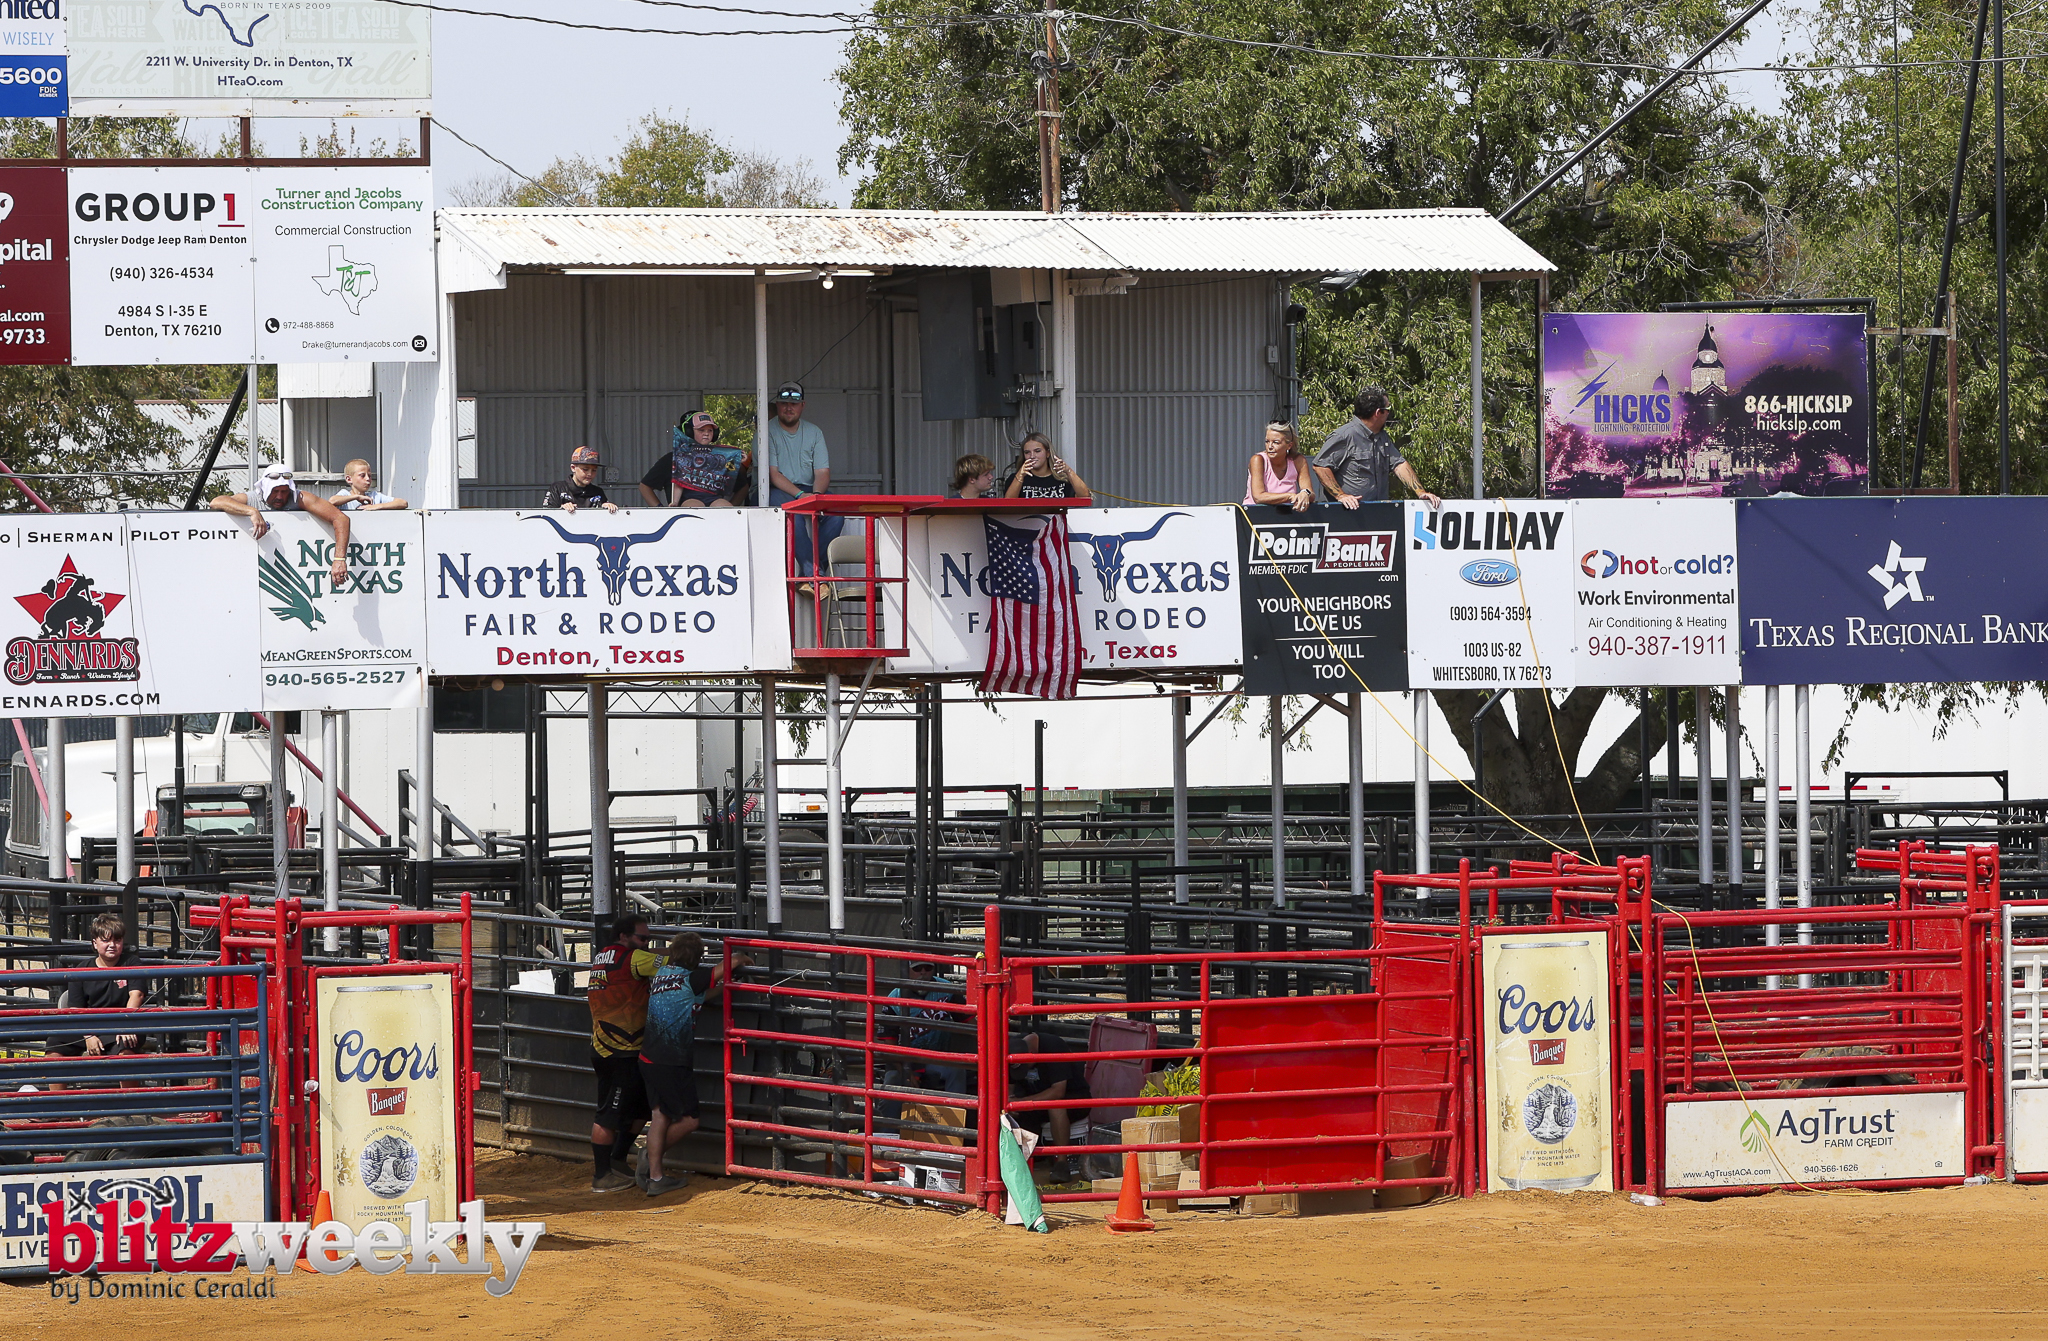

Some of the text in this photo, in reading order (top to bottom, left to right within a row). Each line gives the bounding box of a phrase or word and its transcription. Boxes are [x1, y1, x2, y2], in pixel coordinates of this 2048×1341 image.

[269, 2, 301, 10] TEXAS
[305, 2, 332, 10] 2009
[3, 31, 55, 46] WISELY
[146, 57, 171, 67] 2211
[174, 57, 189, 67] W.
[193, 56, 250, 70] University
[254, 57, 271, 67] Dr.
[274, 57, 285, 67] in
[289, 57, 334, 69] Denton,
[337, 57, 353, 67] TX
[0, 67, 62, 85] 5600
[217, 75, 284, 86] HTeaO.com
[39, 86, 58, 94] FDIC
[276, 187, 402, 199] Turner and Jacobs
[75, 193, 216, 222] GROUP
[261, 198, 423, 211] Construction Company
[275, 224, 412, 236] Commercial Construction
[73, 235, 247, 247] Chrysler Dodge Jeep Ram Denton
[110, 266, 214, 282] (940) 326-4534
[118, 304, 208, 317] 4984 S I-35 E
[104, 324, 222, 338] Denton, TX 76210
[283, 321, 335, 329] 972-488-8868
[302, 340, 409, 350] Drake@turnerandjacobs.com
[1594, 394, 1671, 424] HICKS
[1744, 395, 1853, 414] 866-HICKSLP
[1594, 423, 1670, 433] LIGHTNING PROTECTION
[1756, 414, 1842, 432] hickslp.com
[27, 531, 113, 544] SHERMAN
[131, 529, 239, 542] PILOT POINT
[1413, 511, 1565, 551] HOLIDAY
[1257, 529, 1321, 557] Point
[1325, 536, 1386, 562] Bank
[437, 552, 588, 599] North
[1249, 564, 1308, 575] MEMBER FDIC
[1378, 573, 1399, 582] .com
[1471, 562, 1510, 582] Ford
[1257, 594, 1392, 613] YOUR NEIGHBORS
[1578, 588, 1735, 605] Work Environmental
[1094, 607, 1206, 631] RODEO
[1450, 606, 1532, 621] (903) 564-3594
[465, 611, 715, 636] FAIR & RODEO
[1294, 615, 1362, 631] LOVE US
[1588, 616, 1727, 631] Air Conditioning & Heating
[1749, 614, 2048, 647] TEXAS REGIONAL BANK
[1104, 640, 1178, 660] Texas
[1292, 643, 1365, 660] YOU WILL
[1463, 642, 1522, 657] 1003 US-82
[1588, 635, 1726, 656] 940-387-1911
[6, 640, 137, 683] DENNARDS
[497, 645, 685, 667] Denton, Texas
[265, 670, 406, 687] 940-565-2527
[1313, 664, 1346, 679] TOO
[1433, 665, 1552, 682] WHITESBORO, TX 76273
[1498, 984, 1596, 1034] Coors
[334, 1029, 438, 1083] Coors
[1532, 1041, 1564, 1064] Banquet
[370, 1089, 405, 1115] Banquet
[1775, 1108, 1895, 1144] AgTrust
[1824, 1137, 1893, 1148] FARM CREDIT
[1804, 1163, 1859, 1174] 940-566-1626
